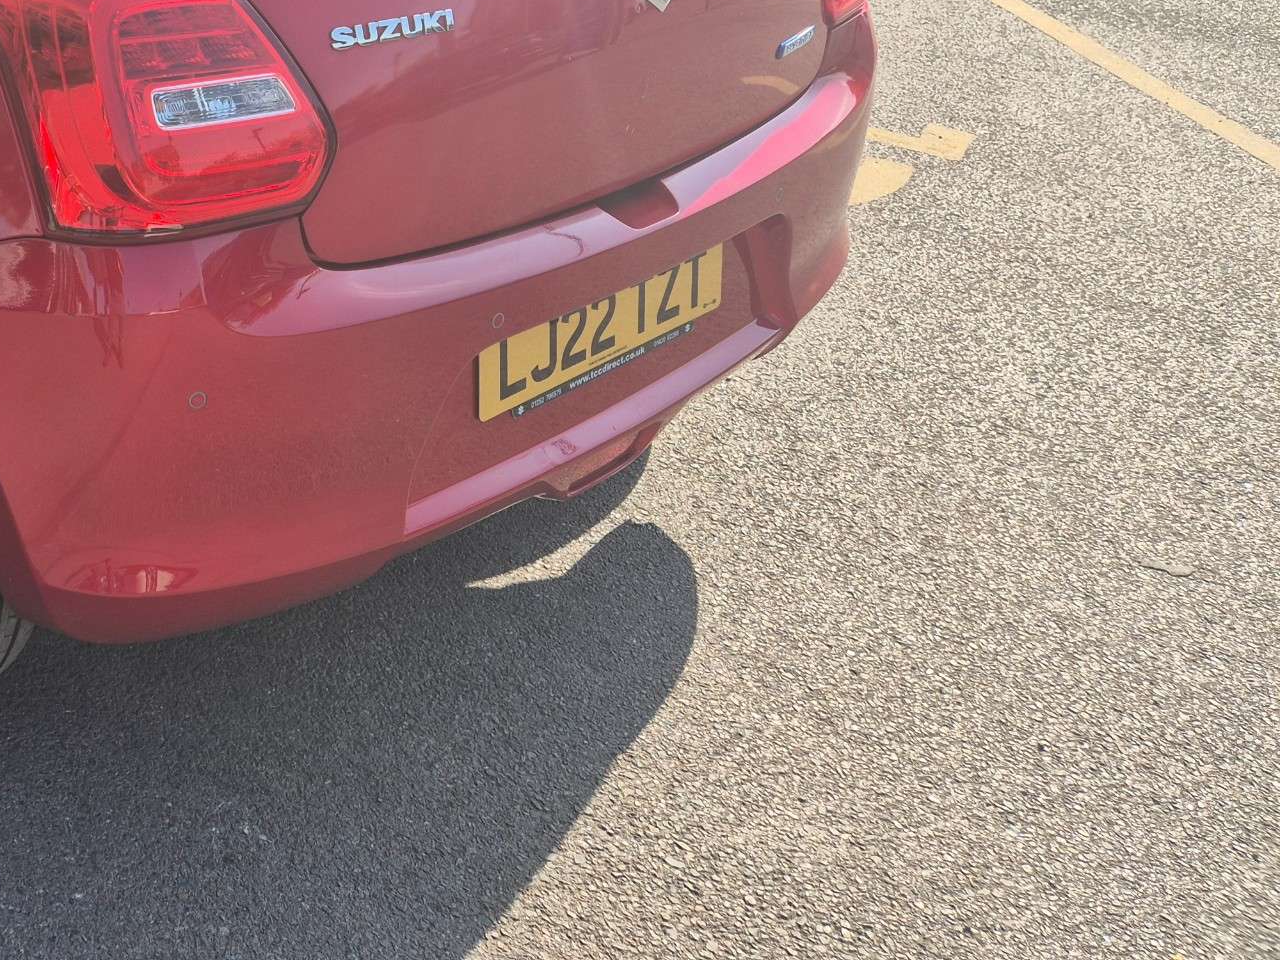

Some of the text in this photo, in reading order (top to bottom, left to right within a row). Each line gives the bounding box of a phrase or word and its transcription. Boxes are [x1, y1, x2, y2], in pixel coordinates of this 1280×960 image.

[331, 8, 455, 50] SUZUKI
[499, 250, 708, 401] LJ22 TZT
